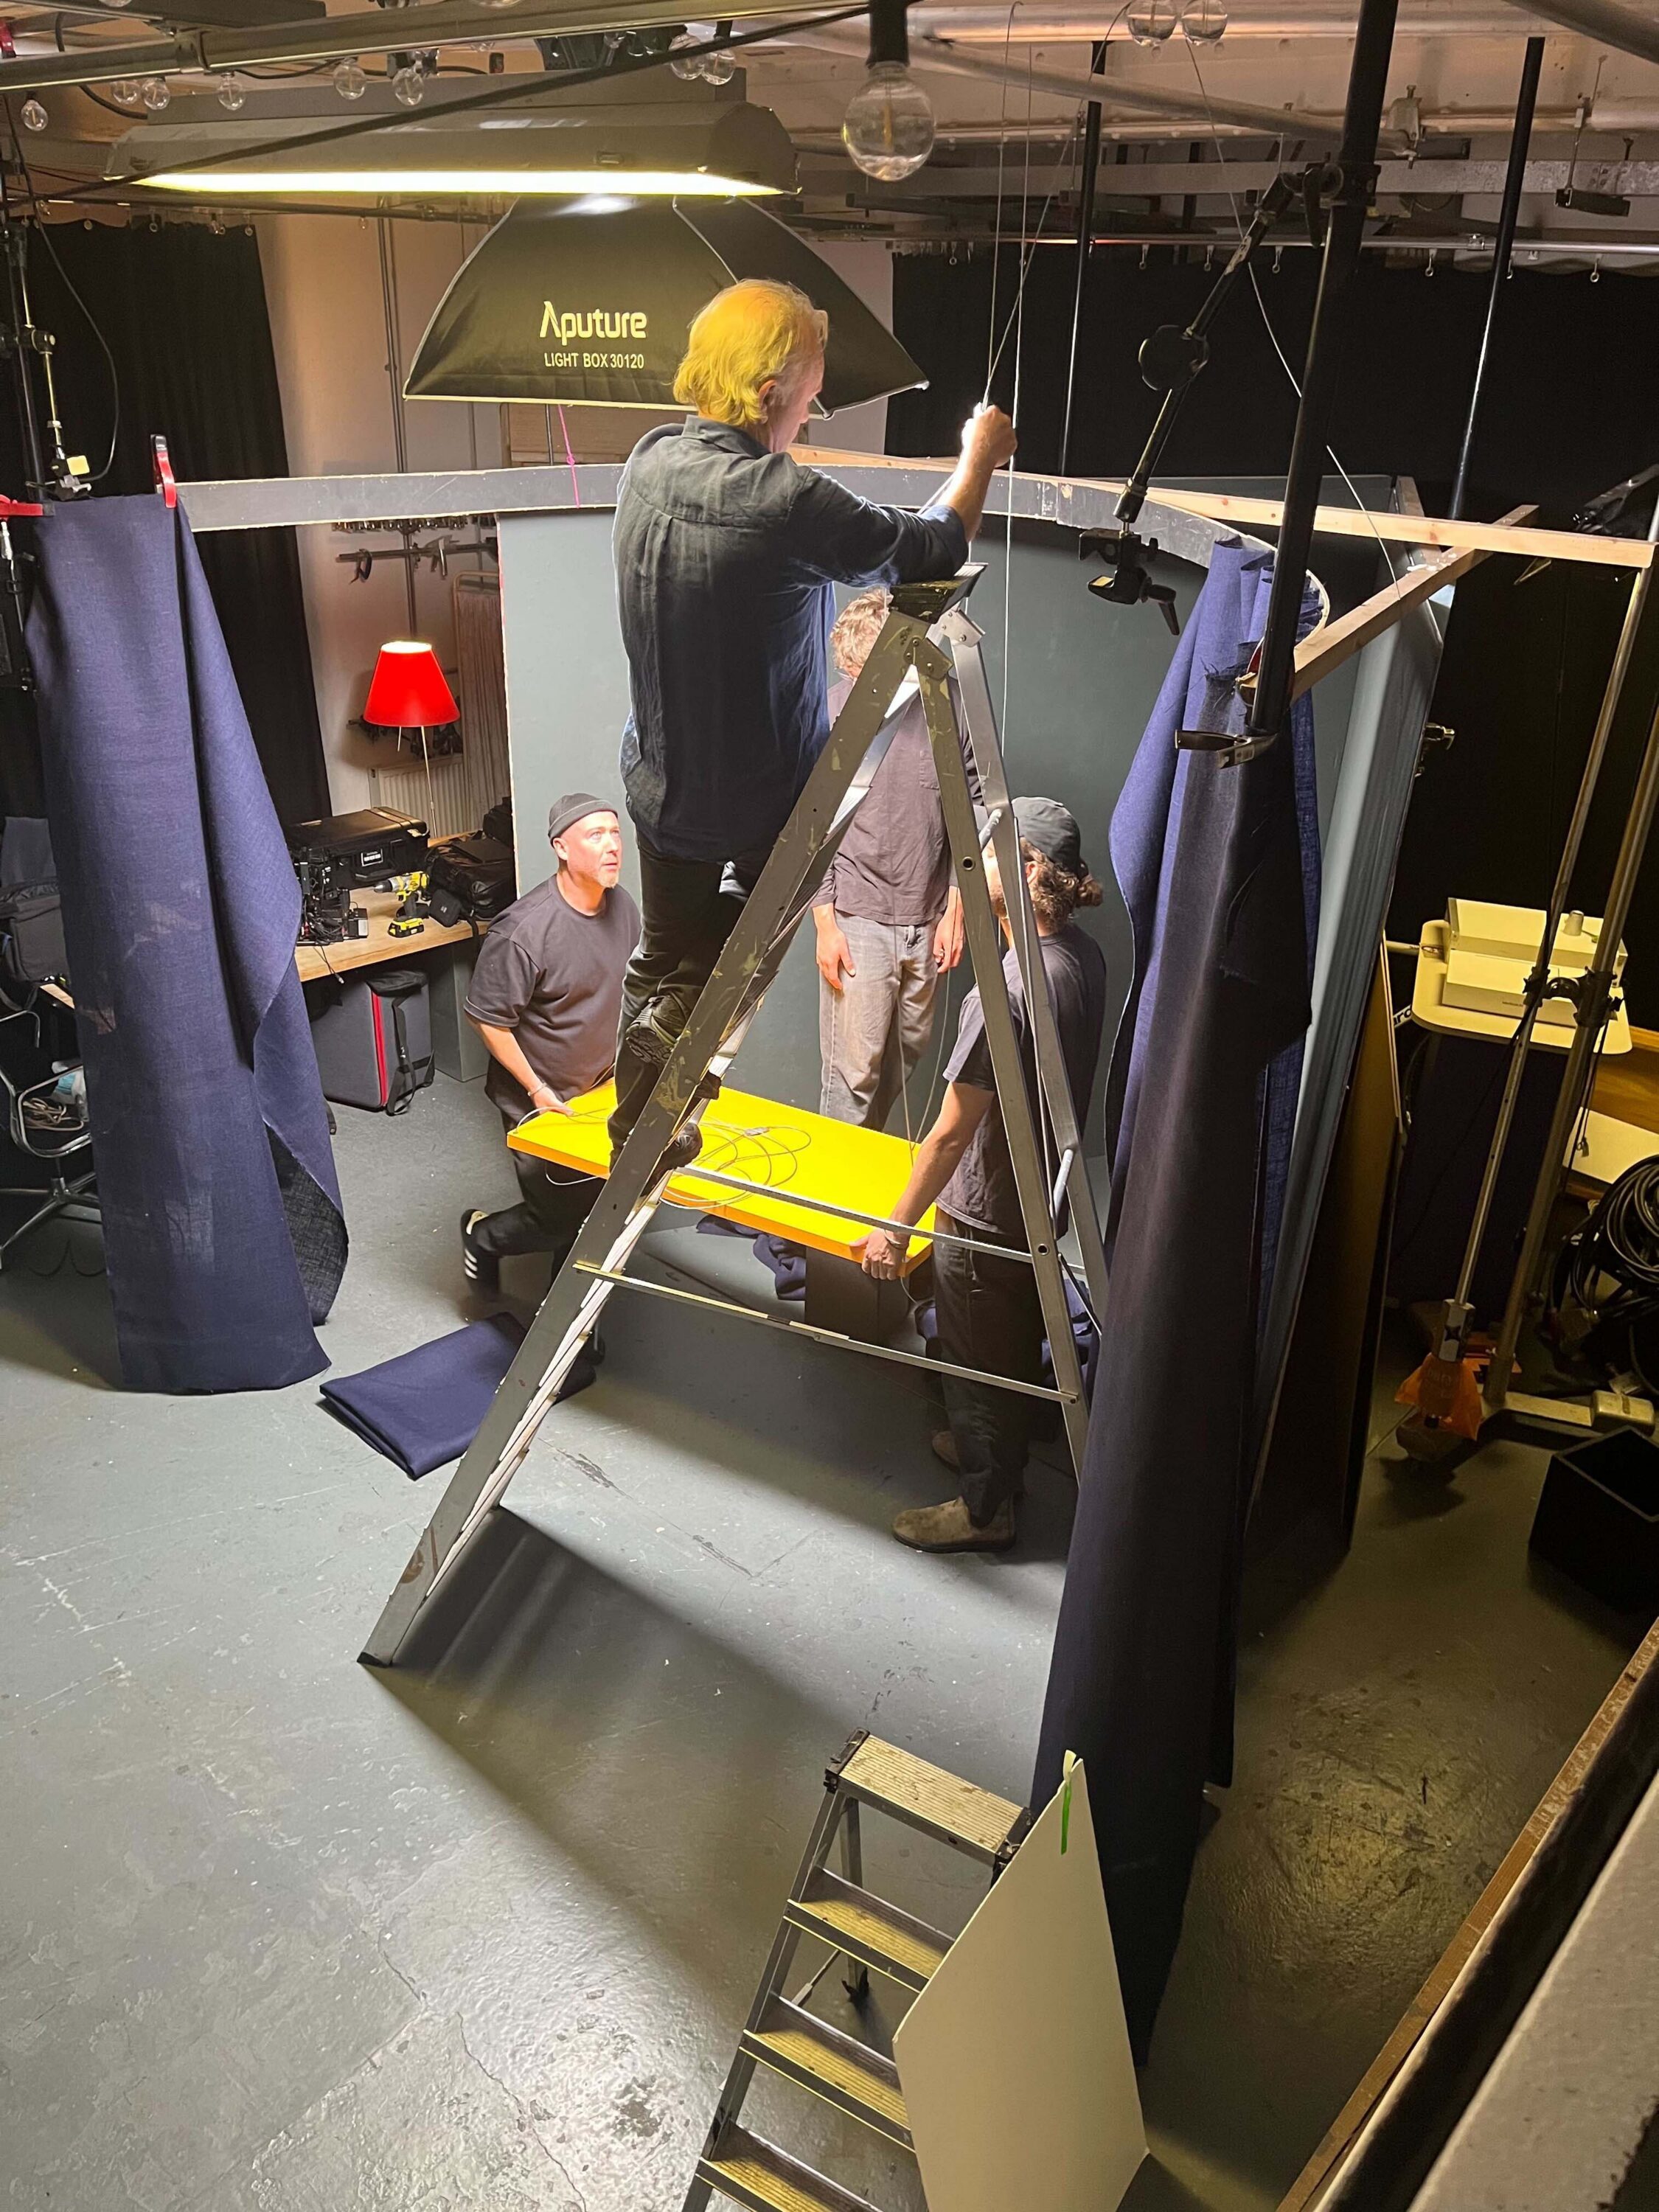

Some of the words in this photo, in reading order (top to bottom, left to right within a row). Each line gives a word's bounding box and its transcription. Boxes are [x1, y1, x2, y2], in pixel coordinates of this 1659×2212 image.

[539, 301, 647, 346] Aputure
[544, 352, 579, 368] LIGHT
[582, 352, 608, 368] BOX
[610, 353, 644, 369] 30120
